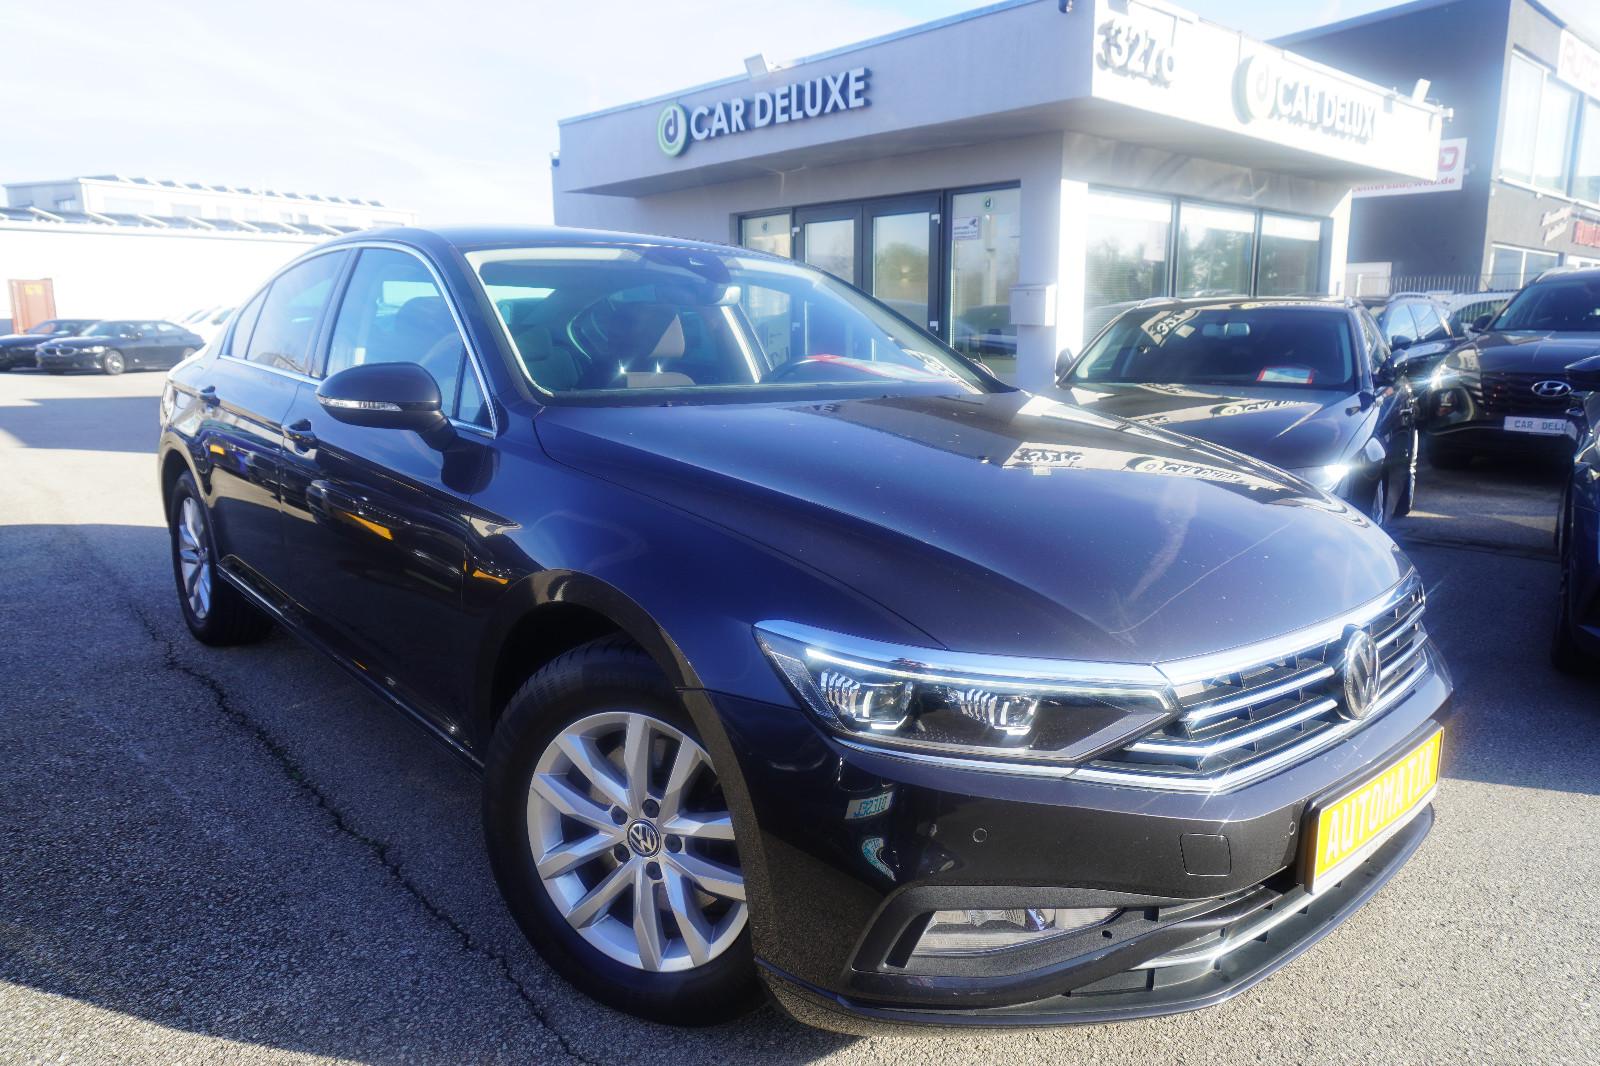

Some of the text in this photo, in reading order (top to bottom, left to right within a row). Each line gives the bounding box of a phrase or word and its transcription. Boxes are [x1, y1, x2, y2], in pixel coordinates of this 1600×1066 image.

[690, 98, 745, 141] CAR
[754, 67, 866, 129] DELUXE
[1322, 90, 1379, 140] DELUX
[1514, 420, 1534, 430] CAR
[1325, 741, 1435, 865] AUTOMATIK
